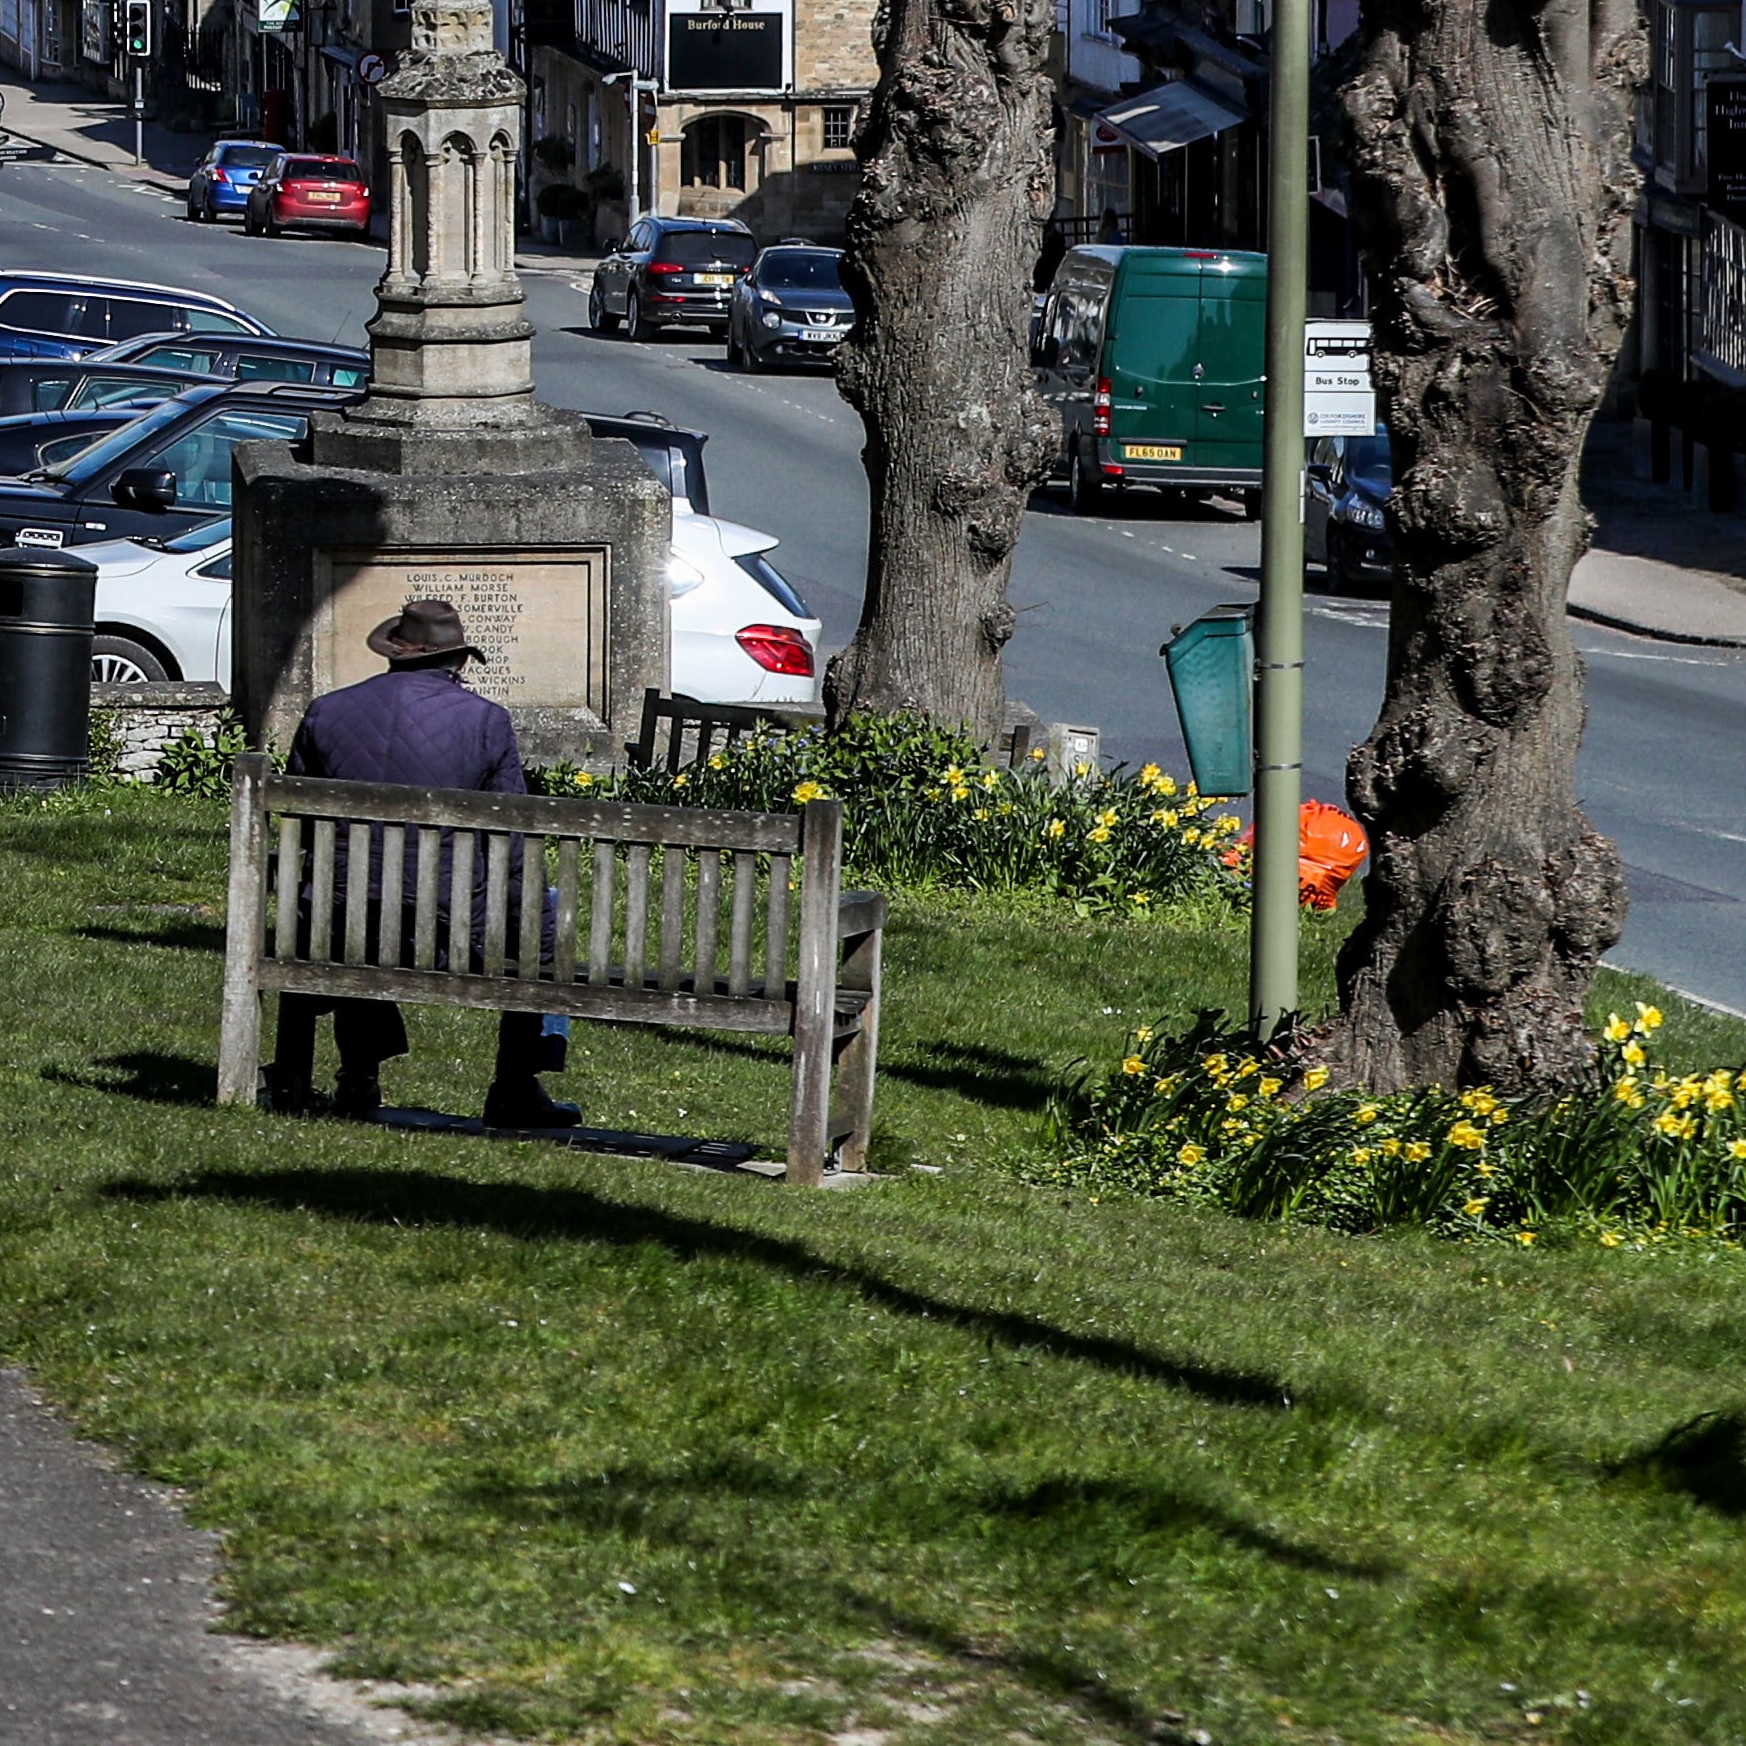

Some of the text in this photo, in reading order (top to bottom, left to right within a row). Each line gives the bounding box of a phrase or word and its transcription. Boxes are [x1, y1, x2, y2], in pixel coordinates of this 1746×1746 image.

[733, 18, 765, 30] House
[1315, 376, 1360, 386] Bus Stop
[1129, 447, 1155, 458] FL65
[459, 574, 514, 582] MURDOCH
[413, 583, 509, 593] WILLIAM MORSE
[473, 594, 518, 603] BURTON
[456, 604, 524, 614] SOMERVILLE
[468, 614, 517, 624] CONWAY
[475, 624, 515, 634] CANDY
[465, 634, 520, 644] BOROUGH
[479, 645, 504, 654] OOK
[476, 675, 527, 685] WICKINS
